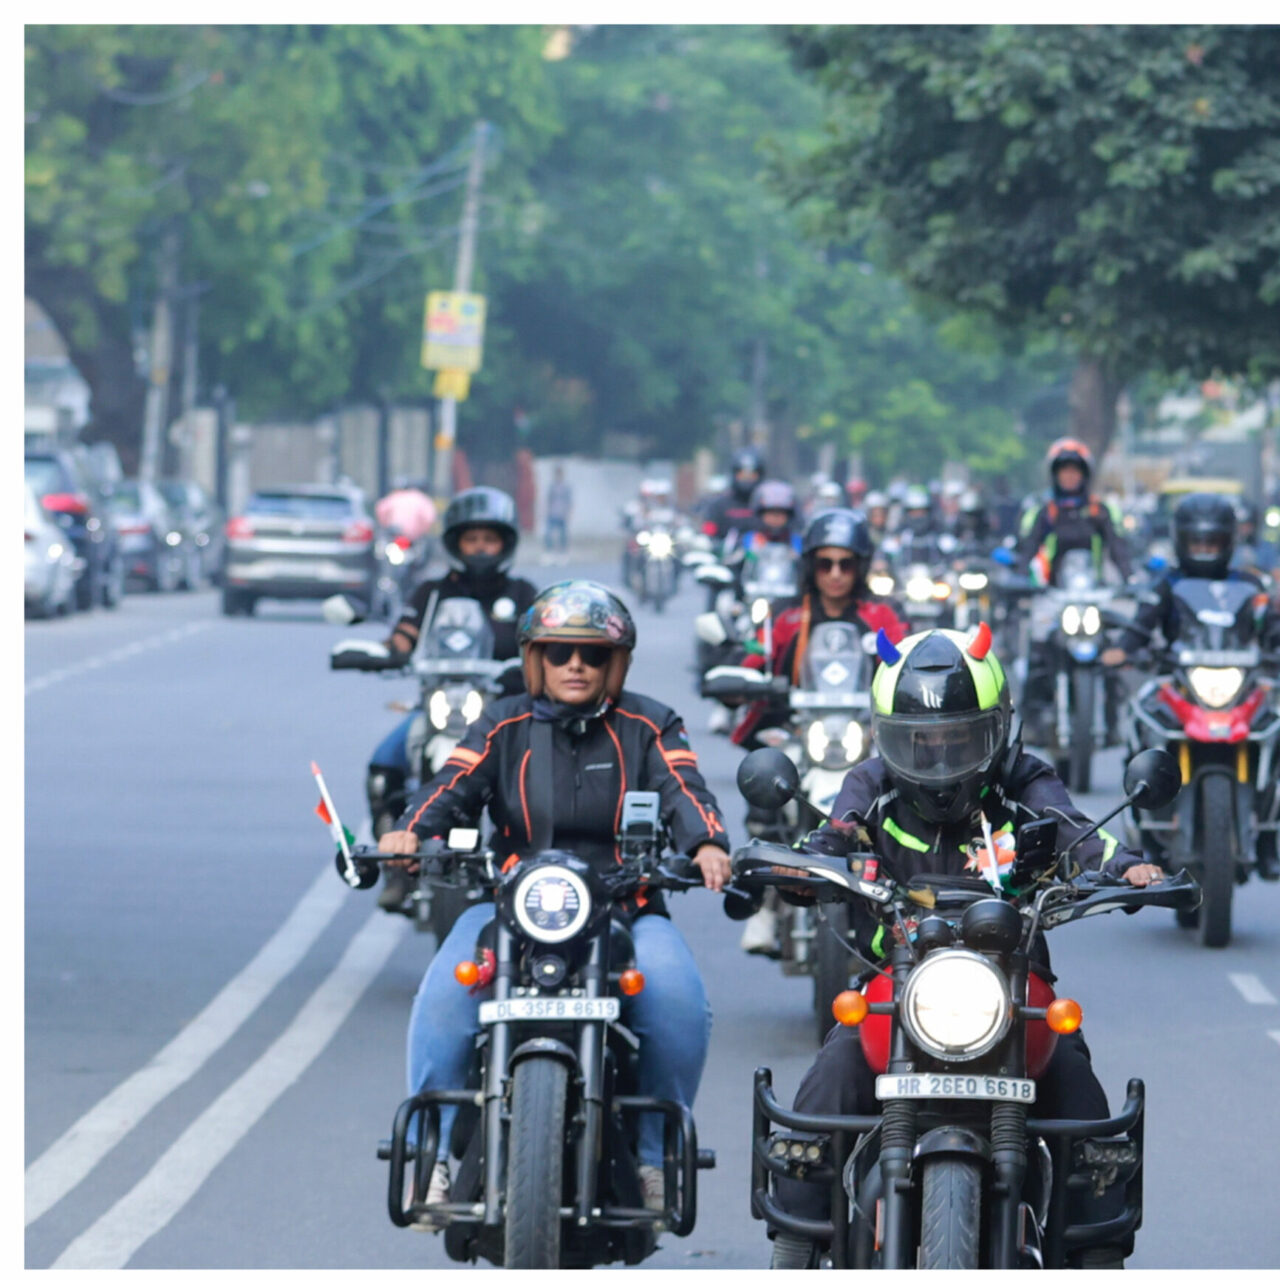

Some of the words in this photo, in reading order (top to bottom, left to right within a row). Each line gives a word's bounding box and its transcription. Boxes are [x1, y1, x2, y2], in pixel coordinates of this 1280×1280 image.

[497, 1004, 515, 1017] DL
[897, 1078, 920, 1094] HR
[985, 1079, 1031, 1099] 6618
